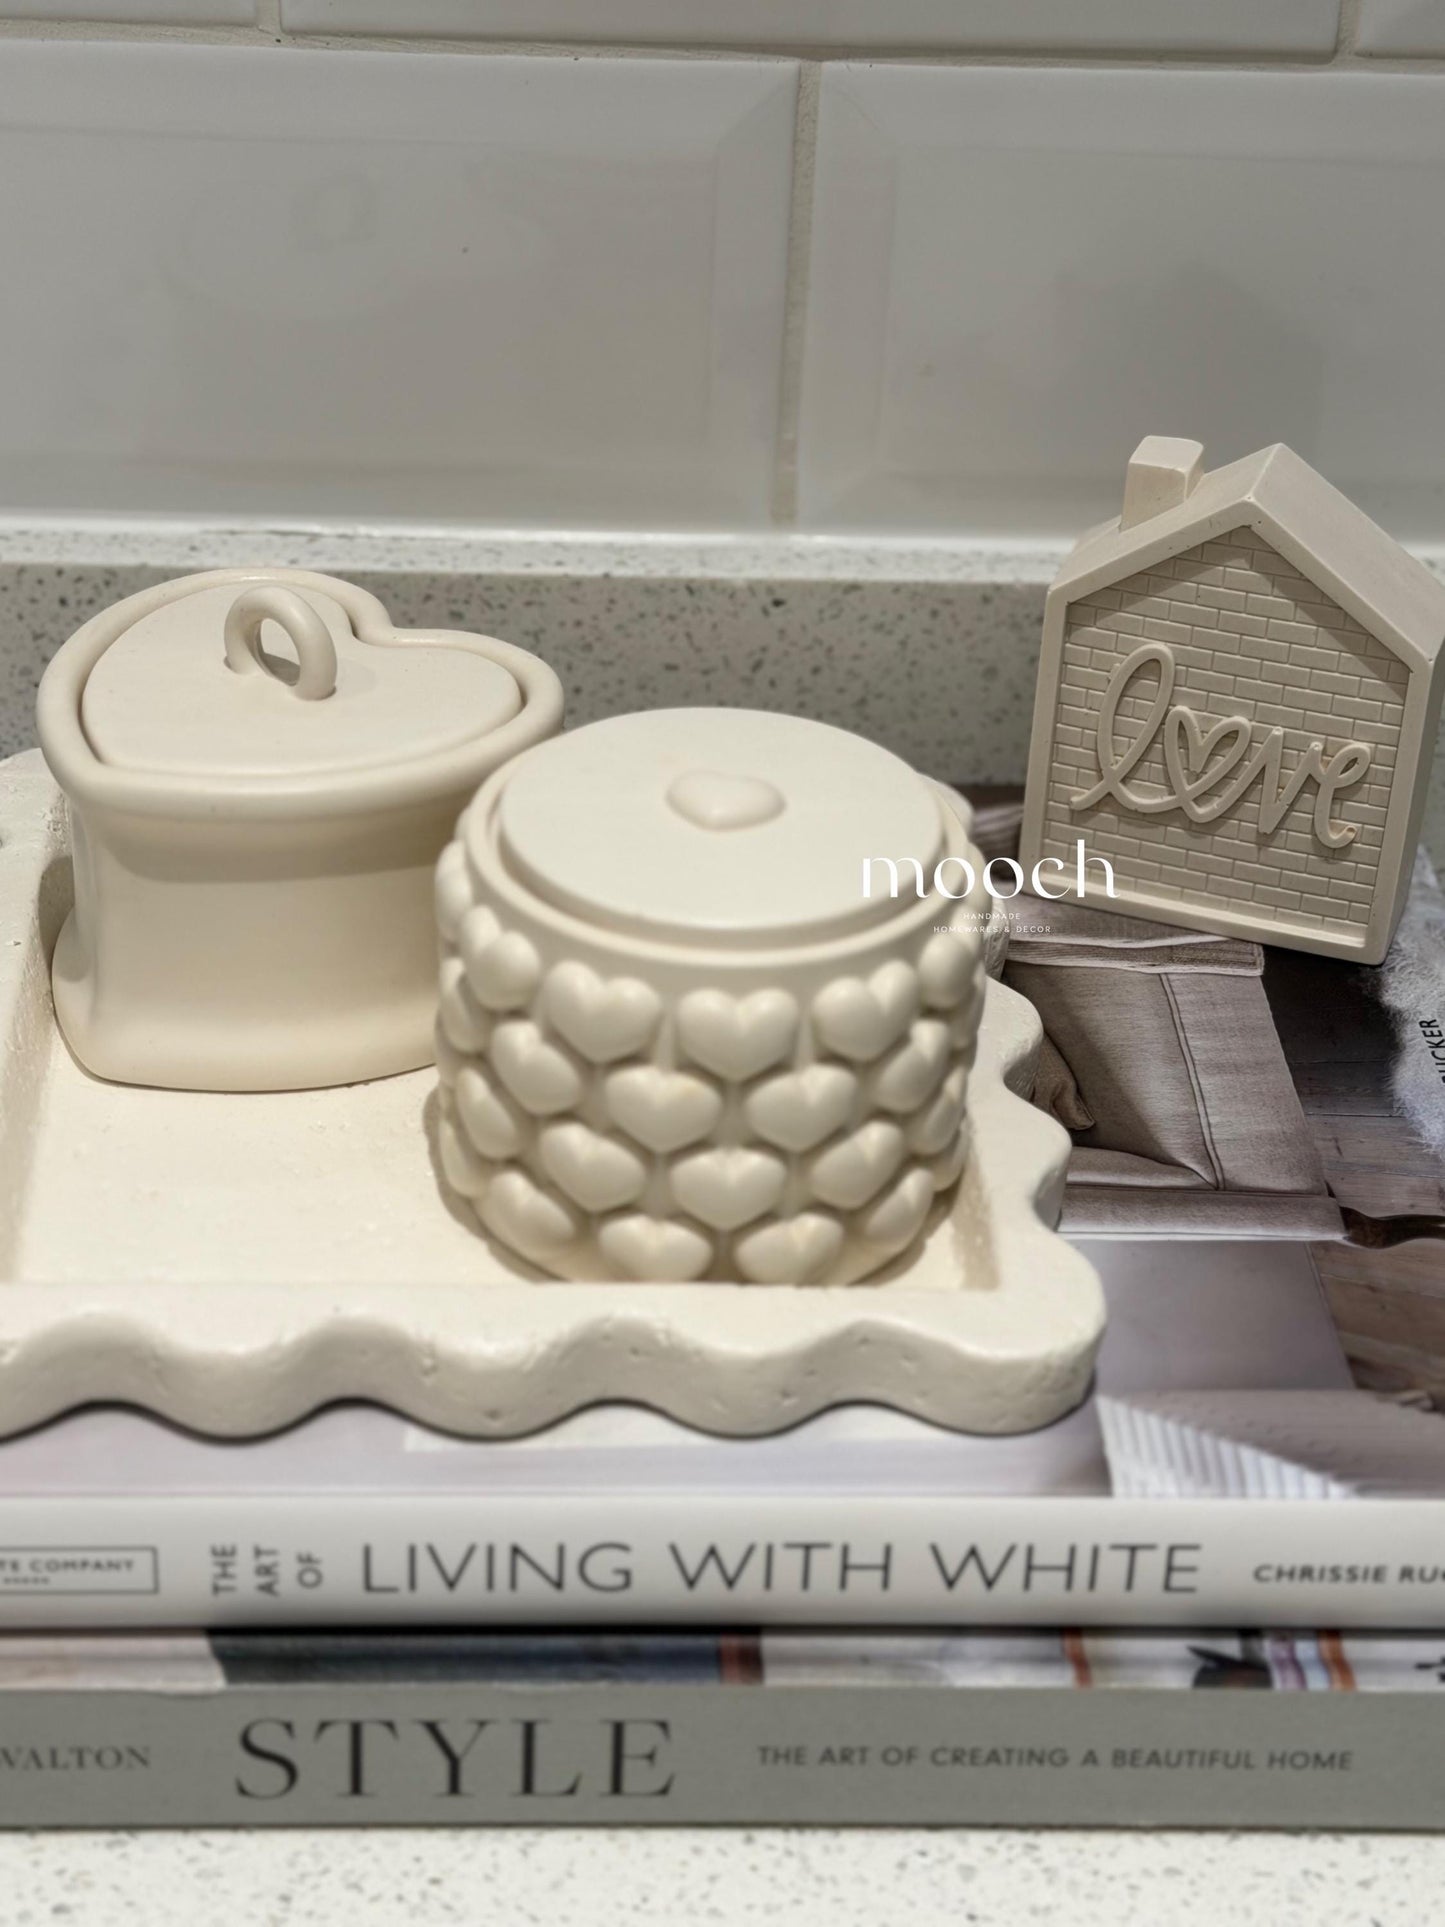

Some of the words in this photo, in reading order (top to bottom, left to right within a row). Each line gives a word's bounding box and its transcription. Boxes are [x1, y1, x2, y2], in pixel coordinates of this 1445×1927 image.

[1070, 642, 1374, 849] love
[29, 1558, 134, 1574] COMPANY
[211, 1543, 238, 1597] THE
[254, 1543, 280, 1597] ART
[296, 1550, 324, 1590] OF
[362, 1542, 634, 1593] LIVING
[668, 1542, 893, 1593] WITH
[930, 1542, 1202, 1594] WHITE
[1253, 1564, 1388, 1584] CHRISSIE
[1399, 1564, 1445, 1584] RU
[235, 1717, 676, 1799] STYLE
[758, 1746, 806, 1767] THE
[818, 1746, 870, 1767] ART
[881, 1746, 919, 1767] OF
[930, 1747, 1069, 1768] CREATING
[1081, 1749, 1099, 1768] A
[1111, 1749, 1256, 1770] BEAUTIFUL
[1268, 1751, 1353, 1771] HOME
